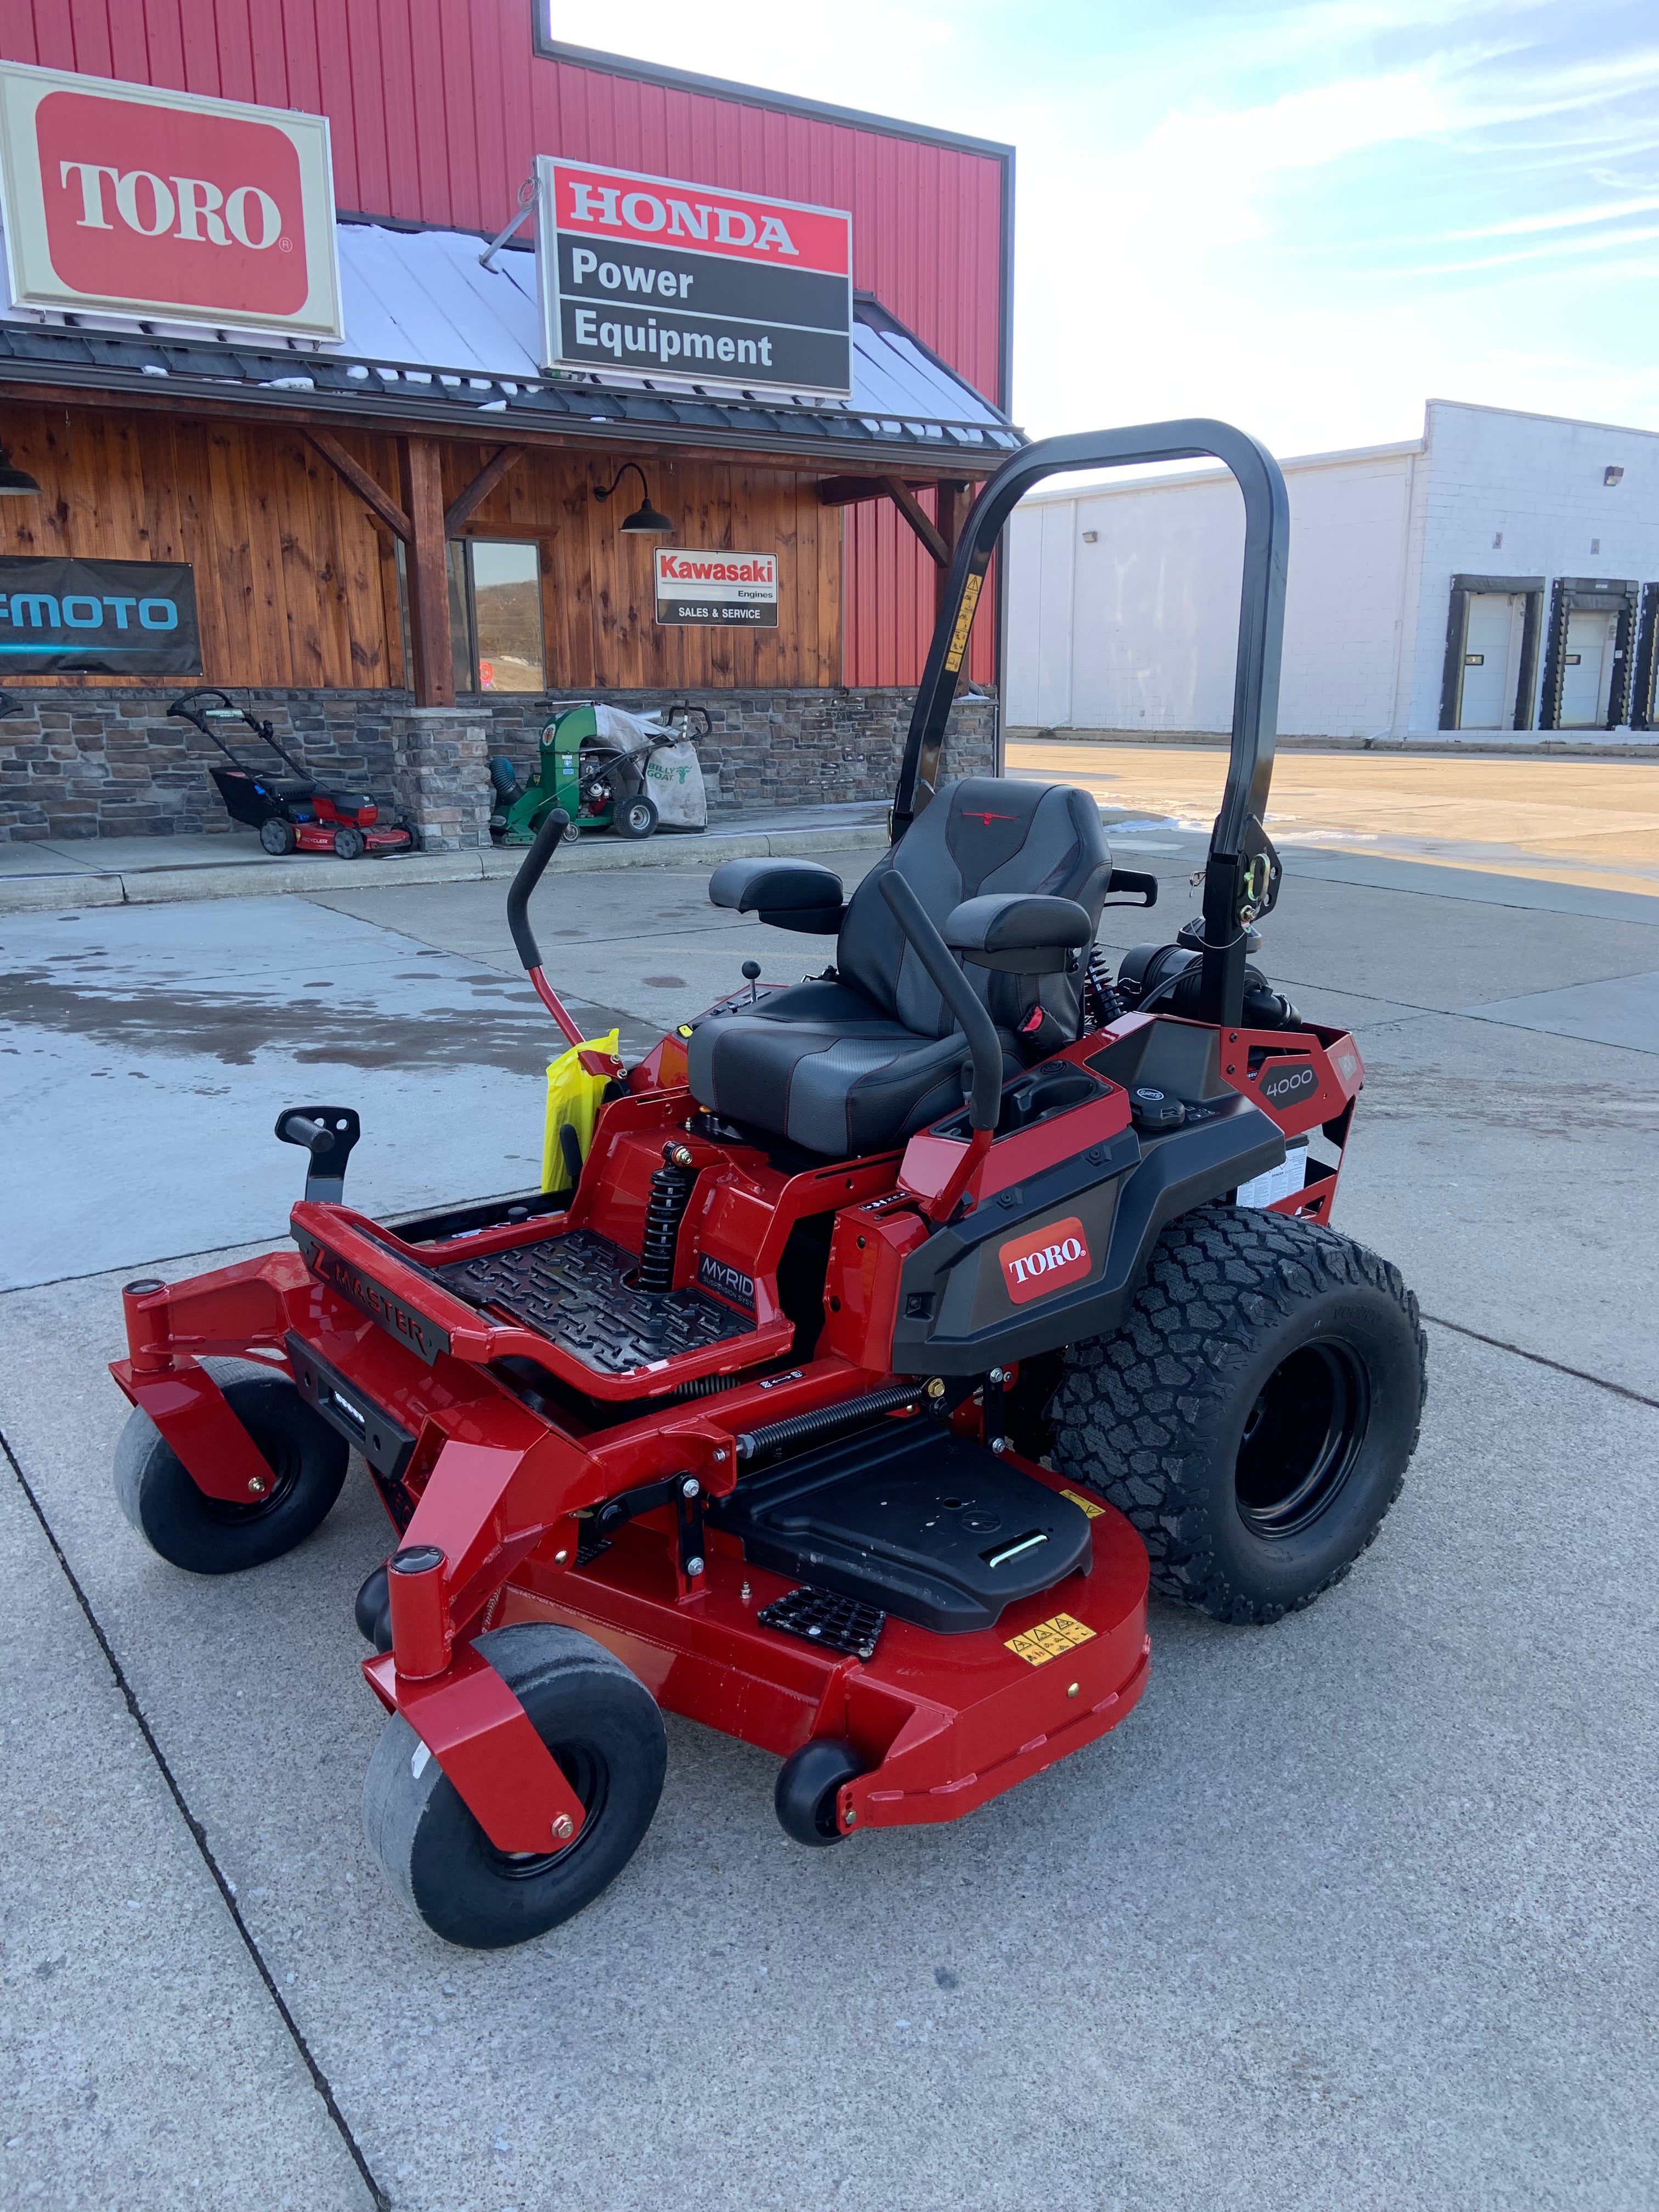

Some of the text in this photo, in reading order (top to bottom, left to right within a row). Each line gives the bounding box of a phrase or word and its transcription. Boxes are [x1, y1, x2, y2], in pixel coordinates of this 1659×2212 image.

[568, 182, 799, 256] HONDA
[572, 247, 694, 298] Power
[575, 308, 773, 366] Equipment
[660, 555, 773, 583] Kawasaki
[738, 590, 773, 599] Engines
[678, 607, 760, 619] SALES & SERVICE
[648, 763, 676, 774] BILLY
[1266, 1069, 1313, 1097] 4000
[311, 1241, 331, 1280] Z
[703, 1276, 737, 1298] SUSPENSION
[335, 1263, 427, 1356] MASTER
